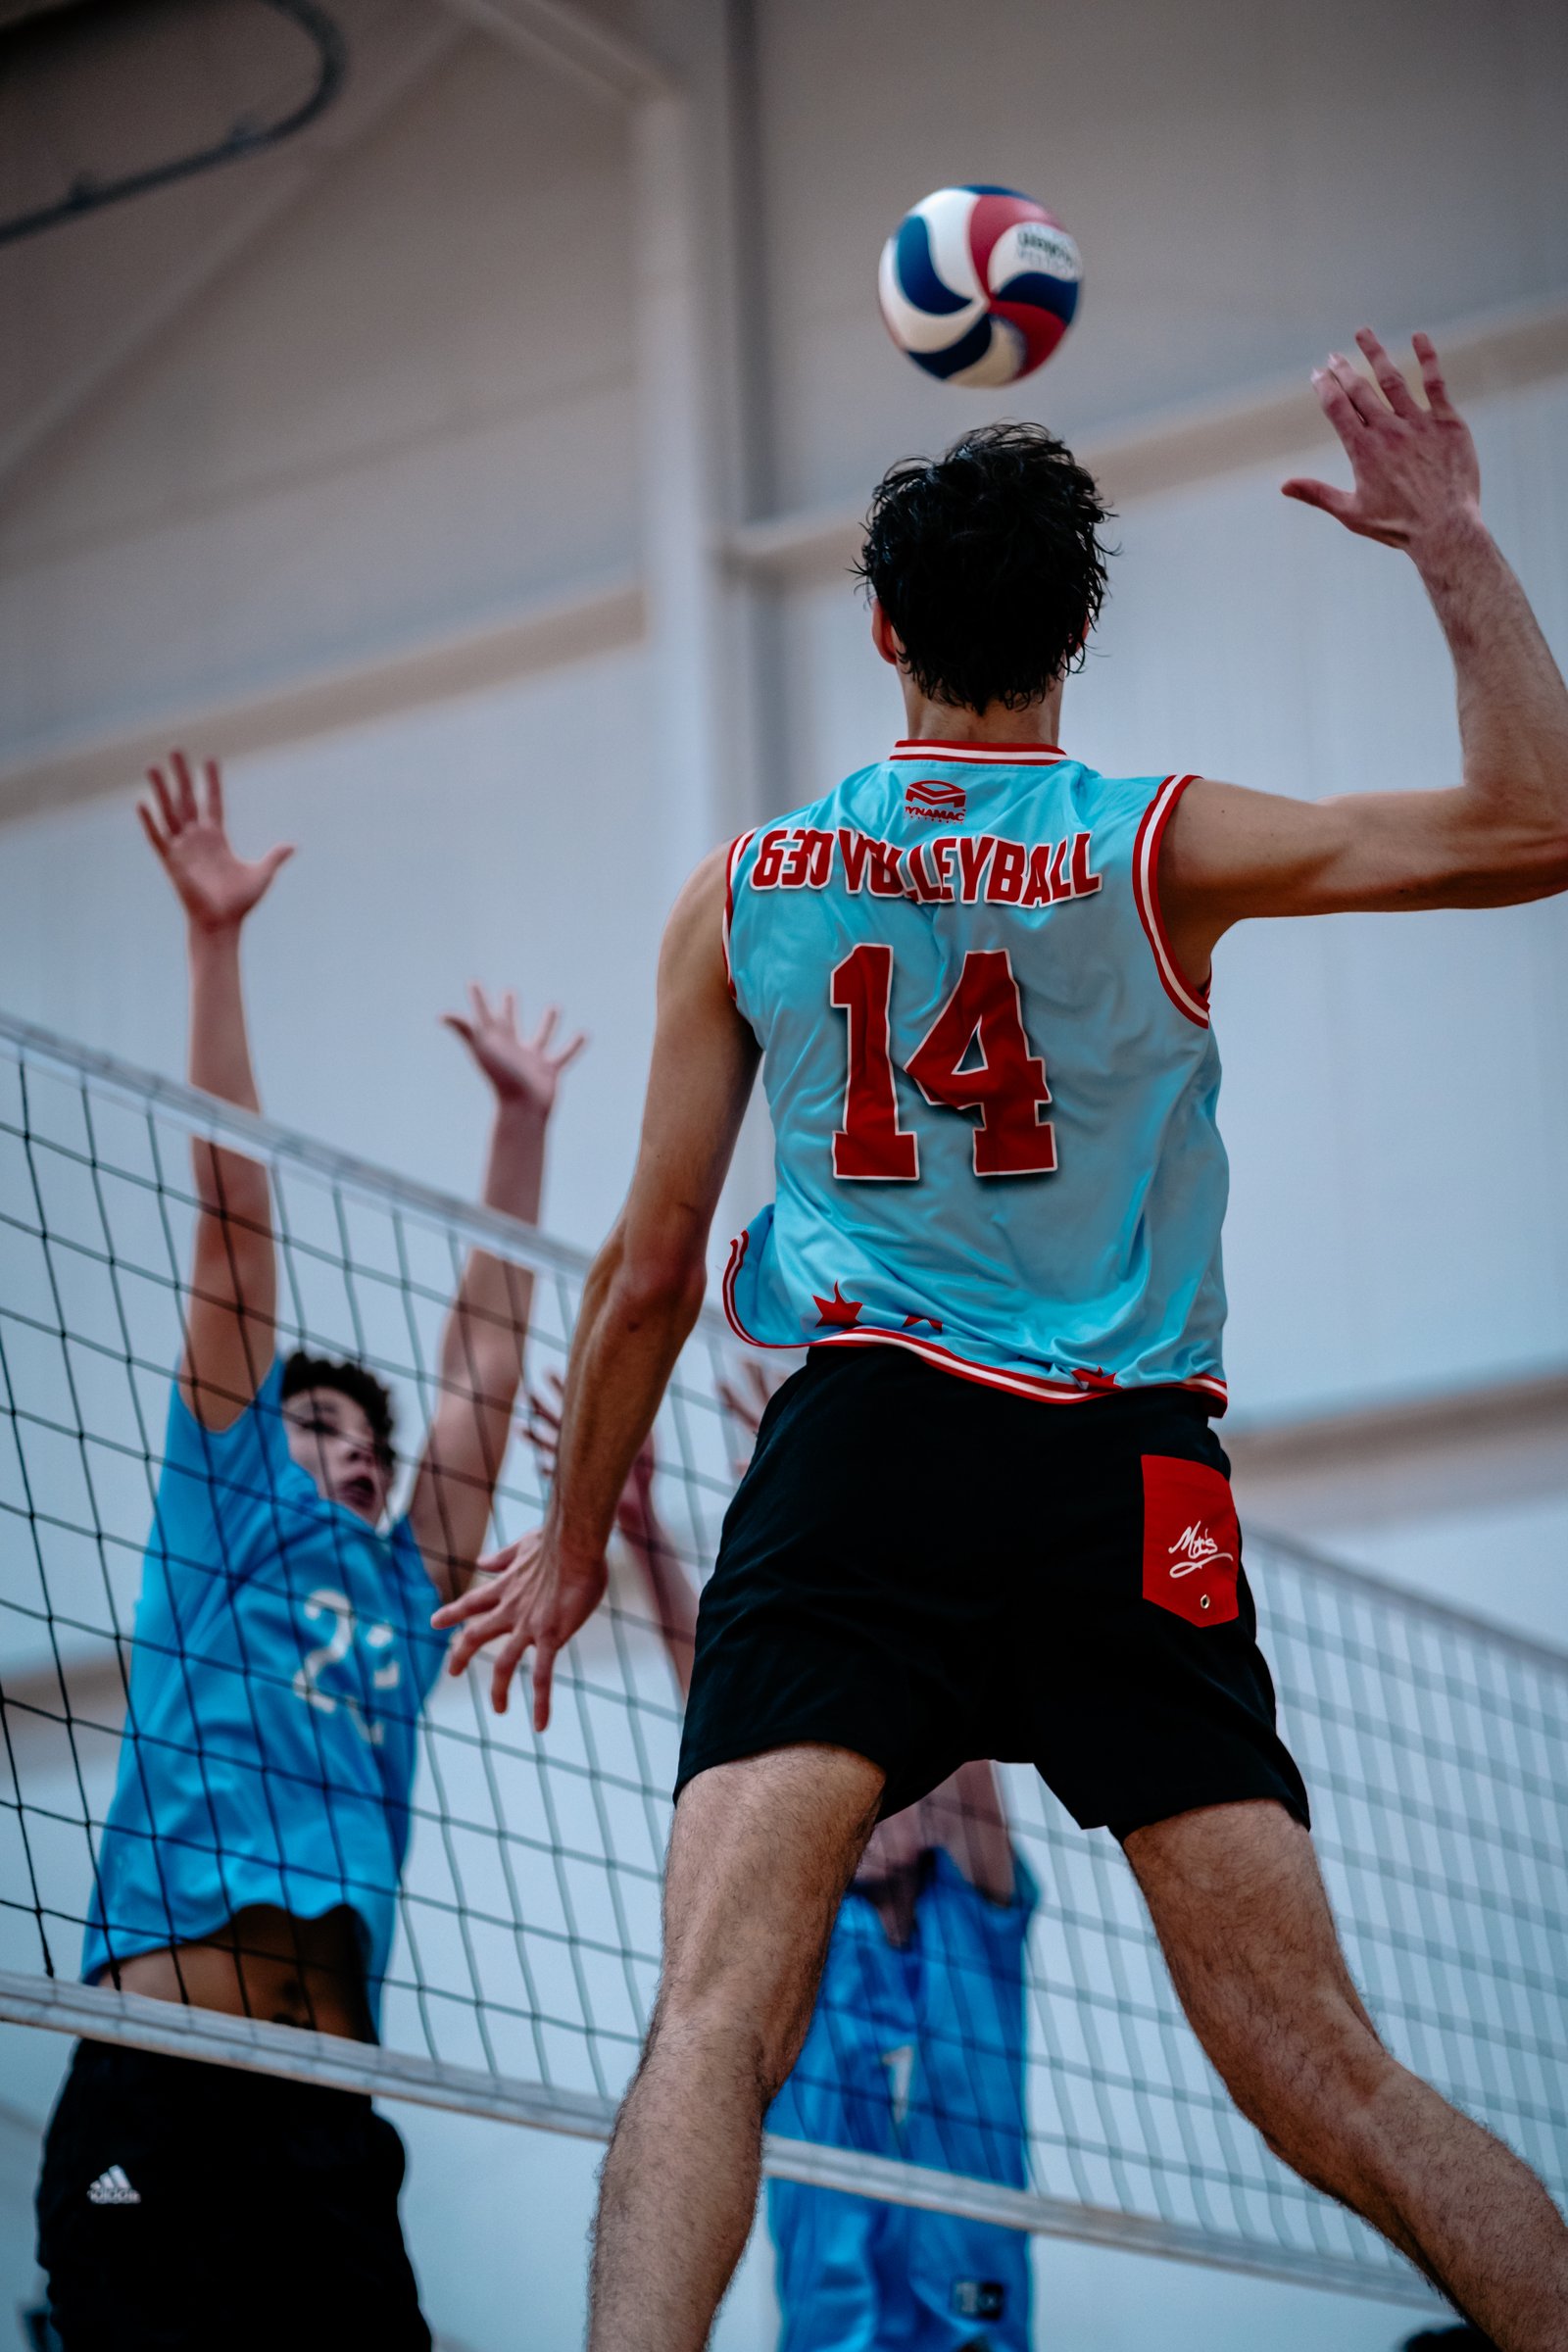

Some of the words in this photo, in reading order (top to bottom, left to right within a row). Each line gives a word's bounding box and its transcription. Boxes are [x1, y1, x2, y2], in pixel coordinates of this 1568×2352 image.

[905, 806, 965, 822] YNAMAC
[750, 828, 835, 891] 630
[829, 942, 1057, 1180] 14
